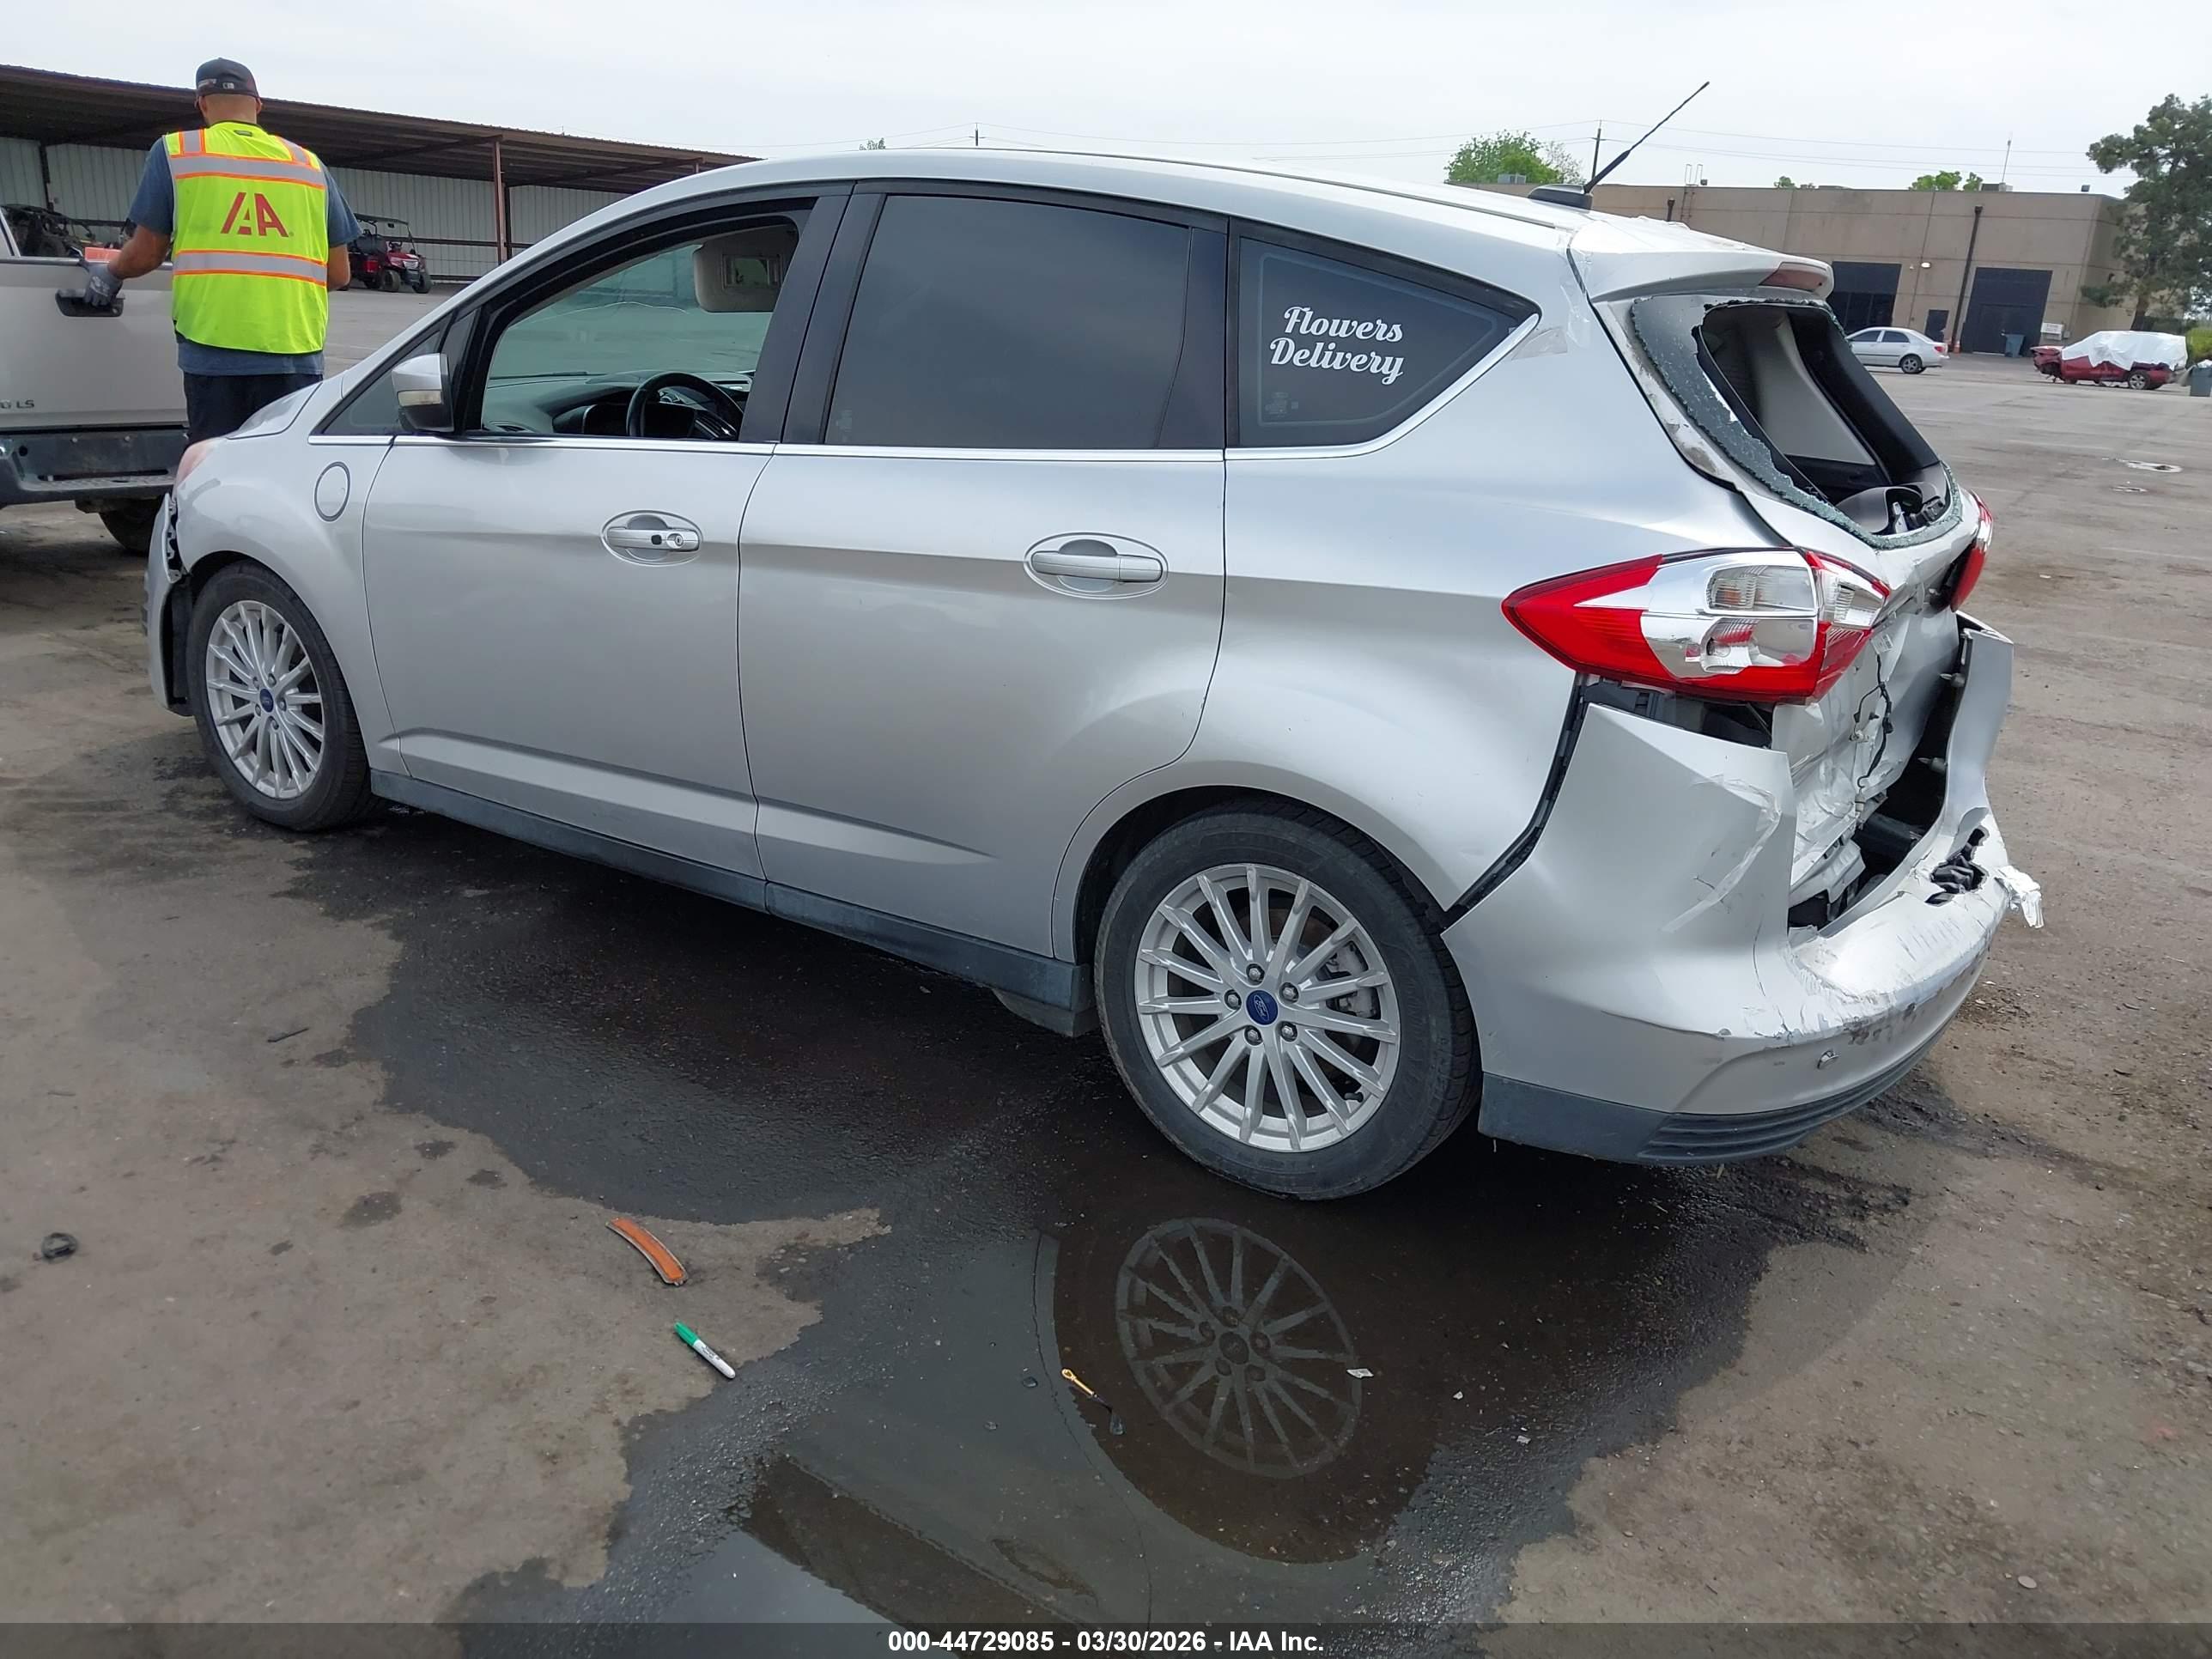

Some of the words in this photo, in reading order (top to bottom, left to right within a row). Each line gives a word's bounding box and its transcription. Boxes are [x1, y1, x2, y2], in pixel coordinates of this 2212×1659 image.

[1284, 306, 1403, 343] Flowers
[1269, 337, 1405, 386] Delivery
[16, 399, 35, 409] LS
